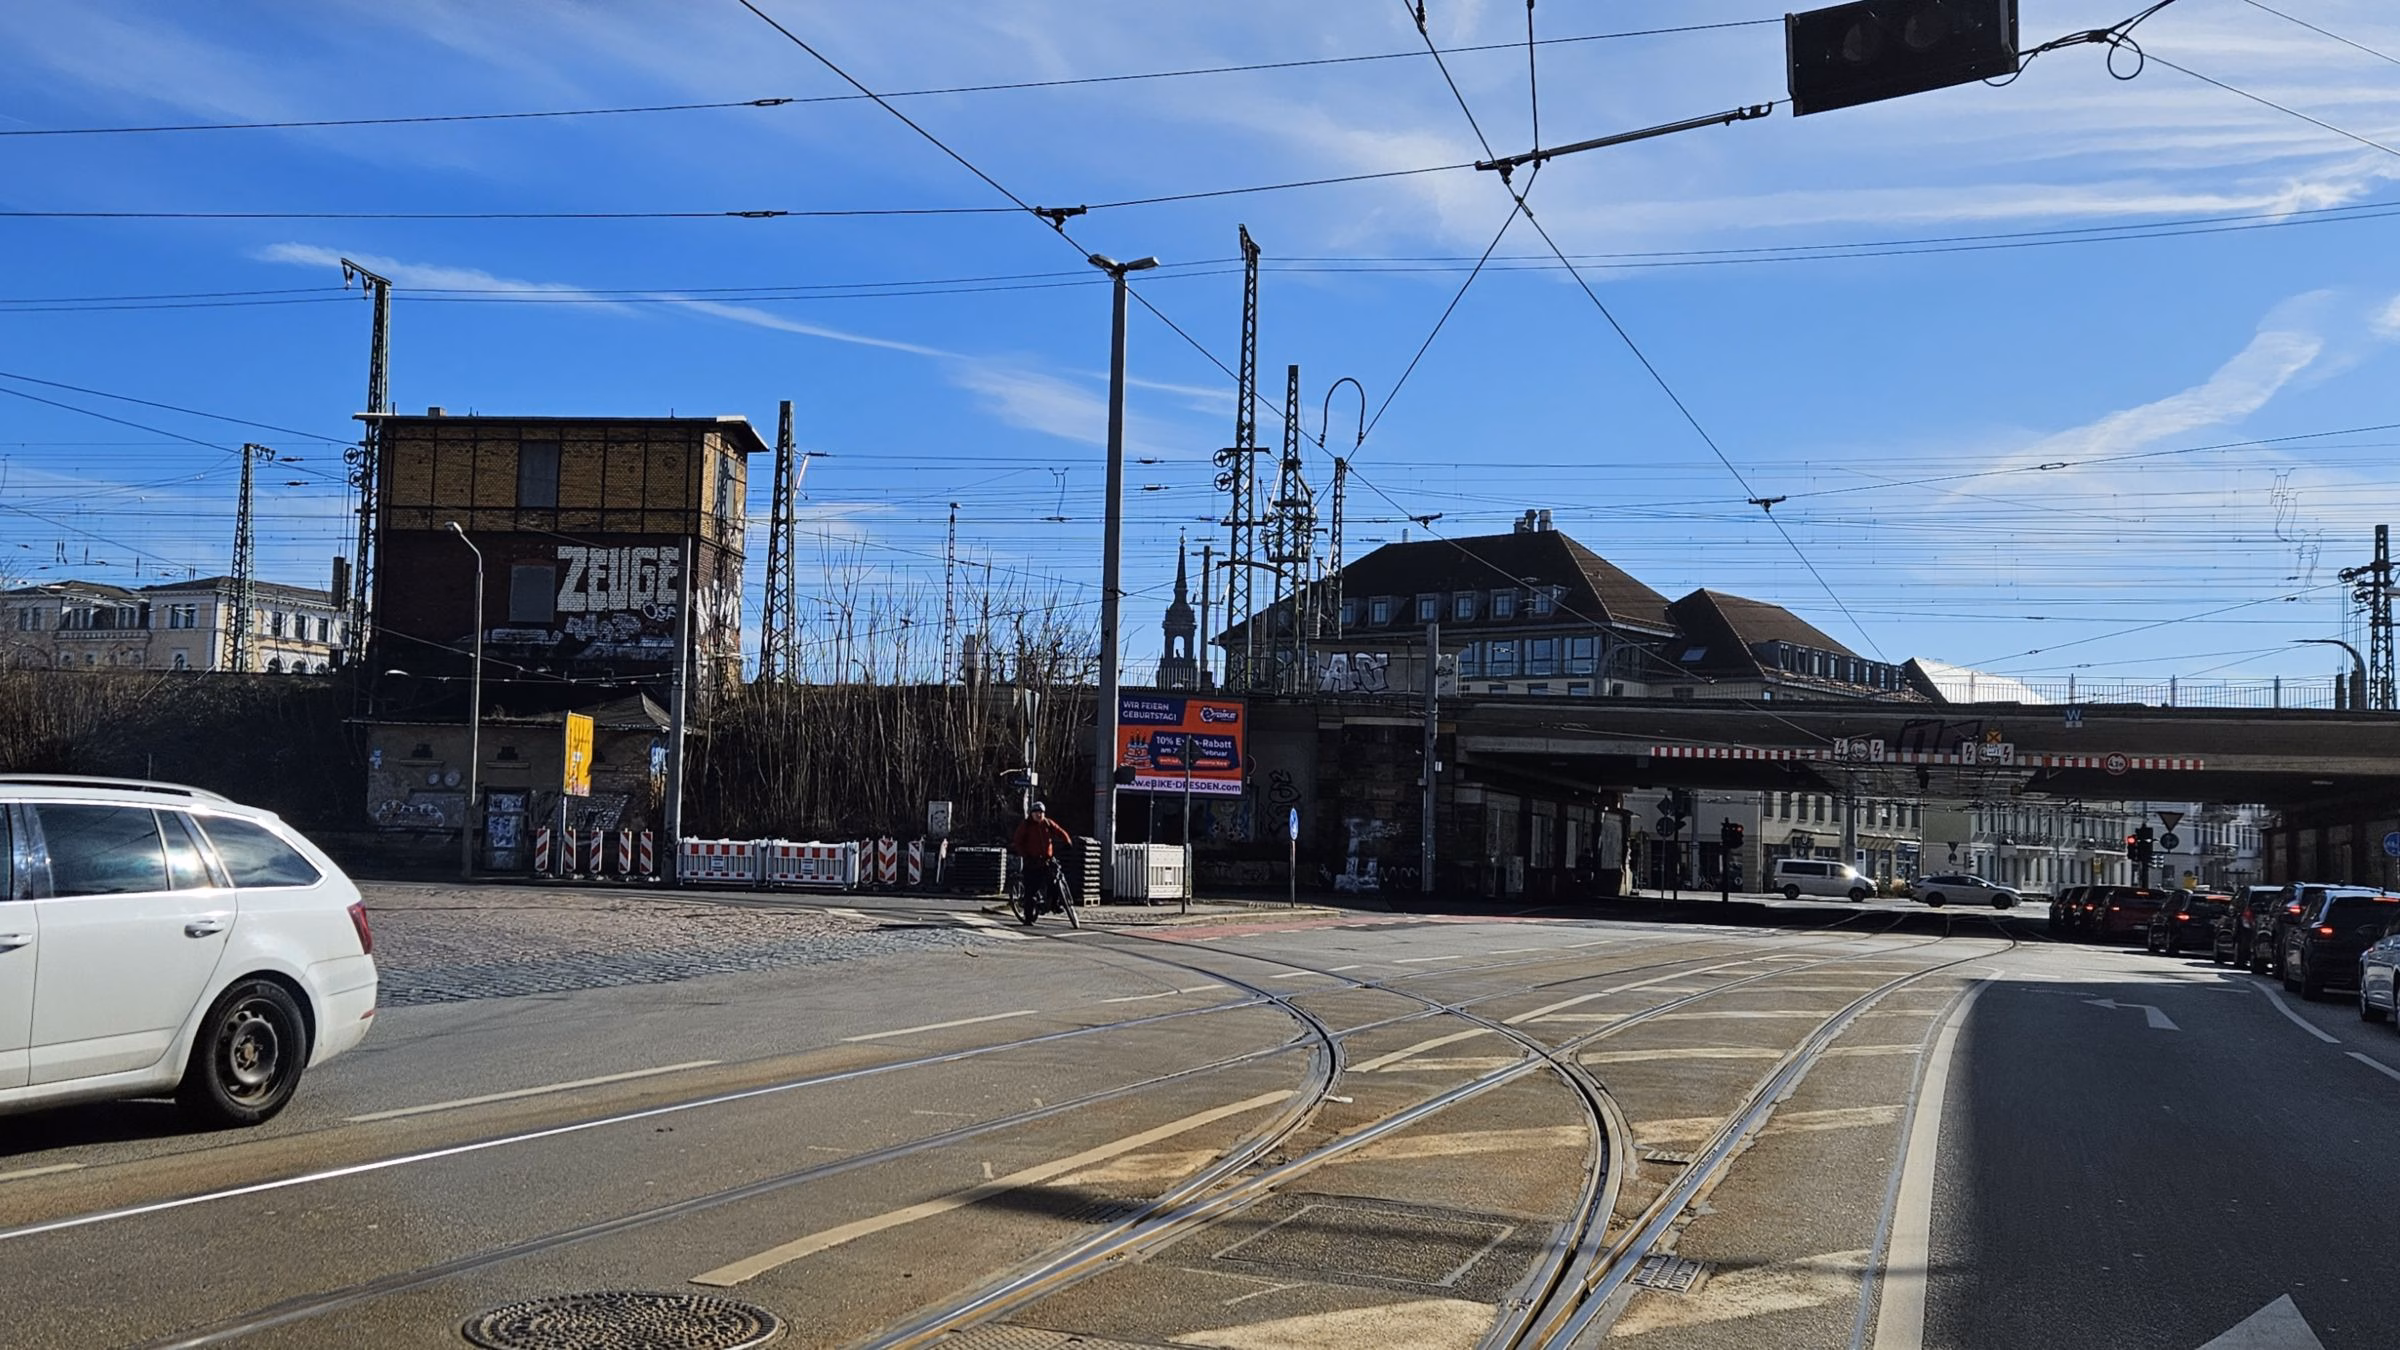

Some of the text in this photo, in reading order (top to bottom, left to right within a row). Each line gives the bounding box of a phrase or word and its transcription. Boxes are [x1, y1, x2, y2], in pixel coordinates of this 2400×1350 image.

[557, 546, 680, 612] ZEUGE
[1123, 701, 1169, 710] WIR FEIERN
[1122, 711, 1177, 721] GEBURTSTAG!
[2066, 709, 2081, 720] W
[1156, 736, 1232, 749] 10% E-Rabatt
